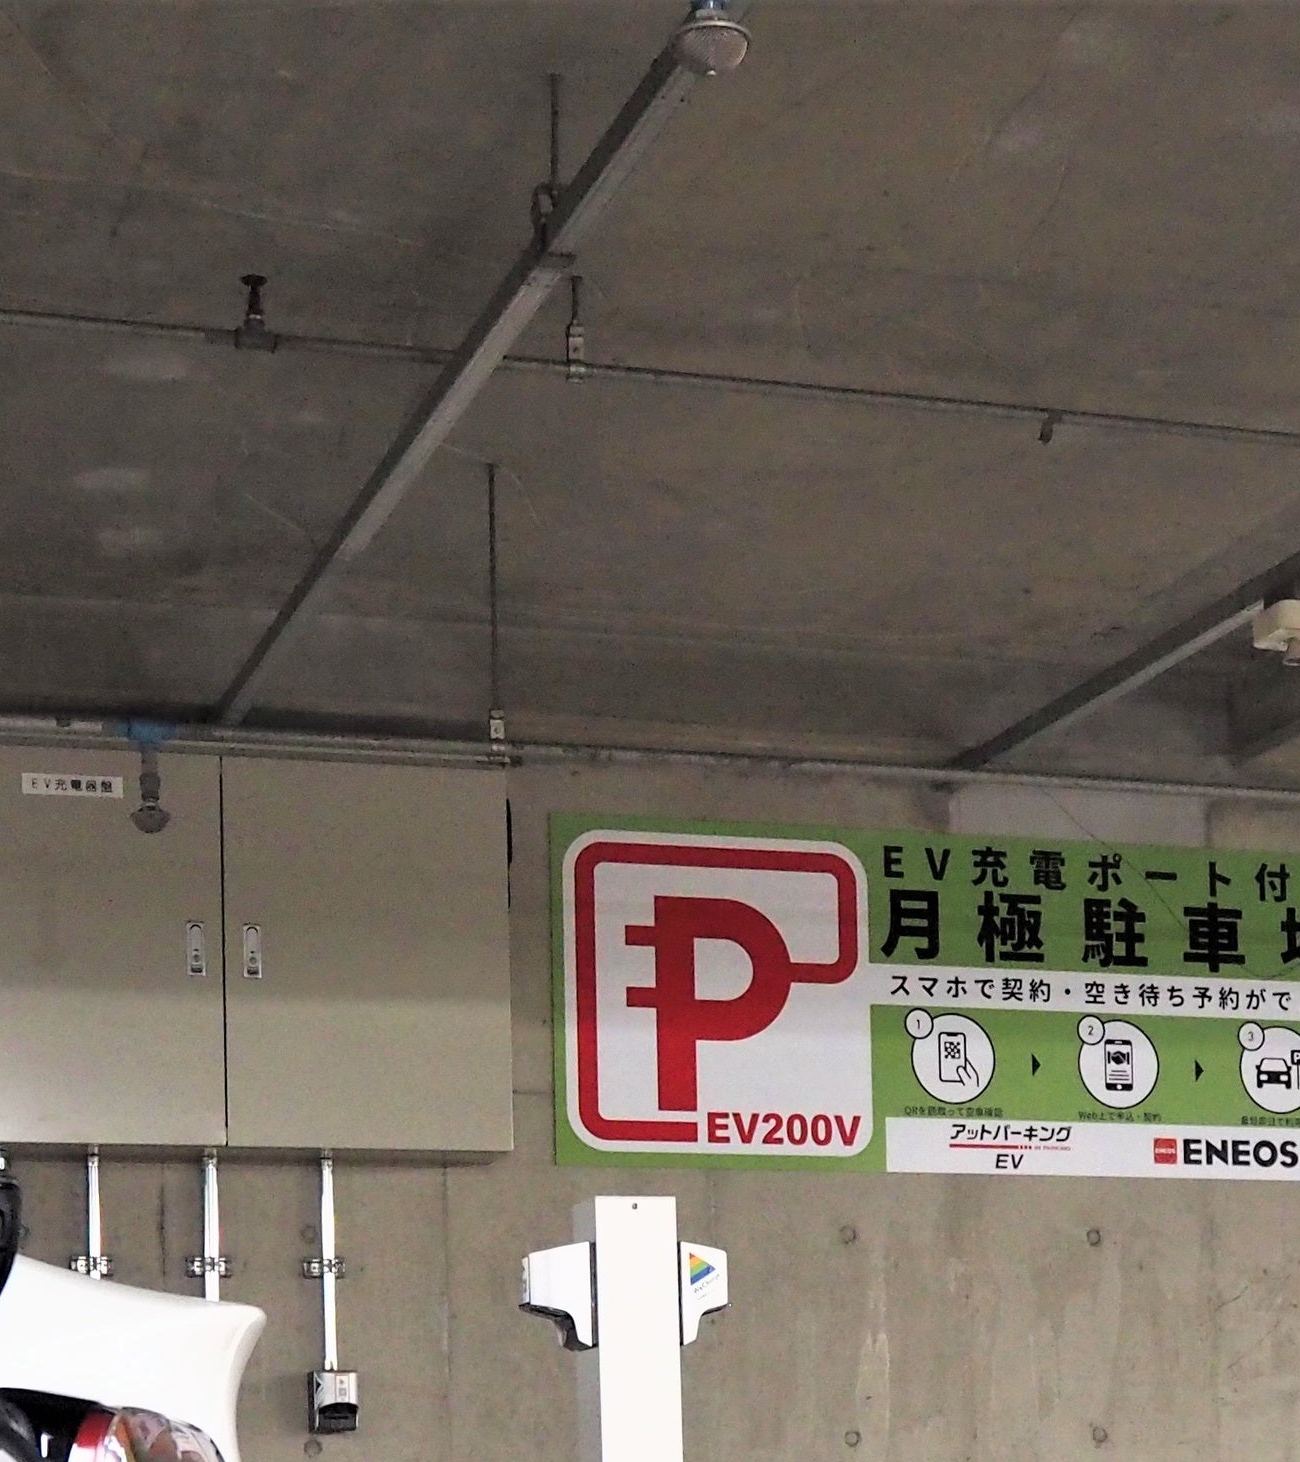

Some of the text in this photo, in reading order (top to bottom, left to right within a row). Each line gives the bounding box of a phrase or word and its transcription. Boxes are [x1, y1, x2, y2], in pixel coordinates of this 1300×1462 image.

[706, 1111, 861, 1147] EV200V
[950, 1124, 1072, 1142] アットパーキング
[995, 1154, 1024, 1169] EV
[1183, 1138, 1299, 1168] ENEOS
